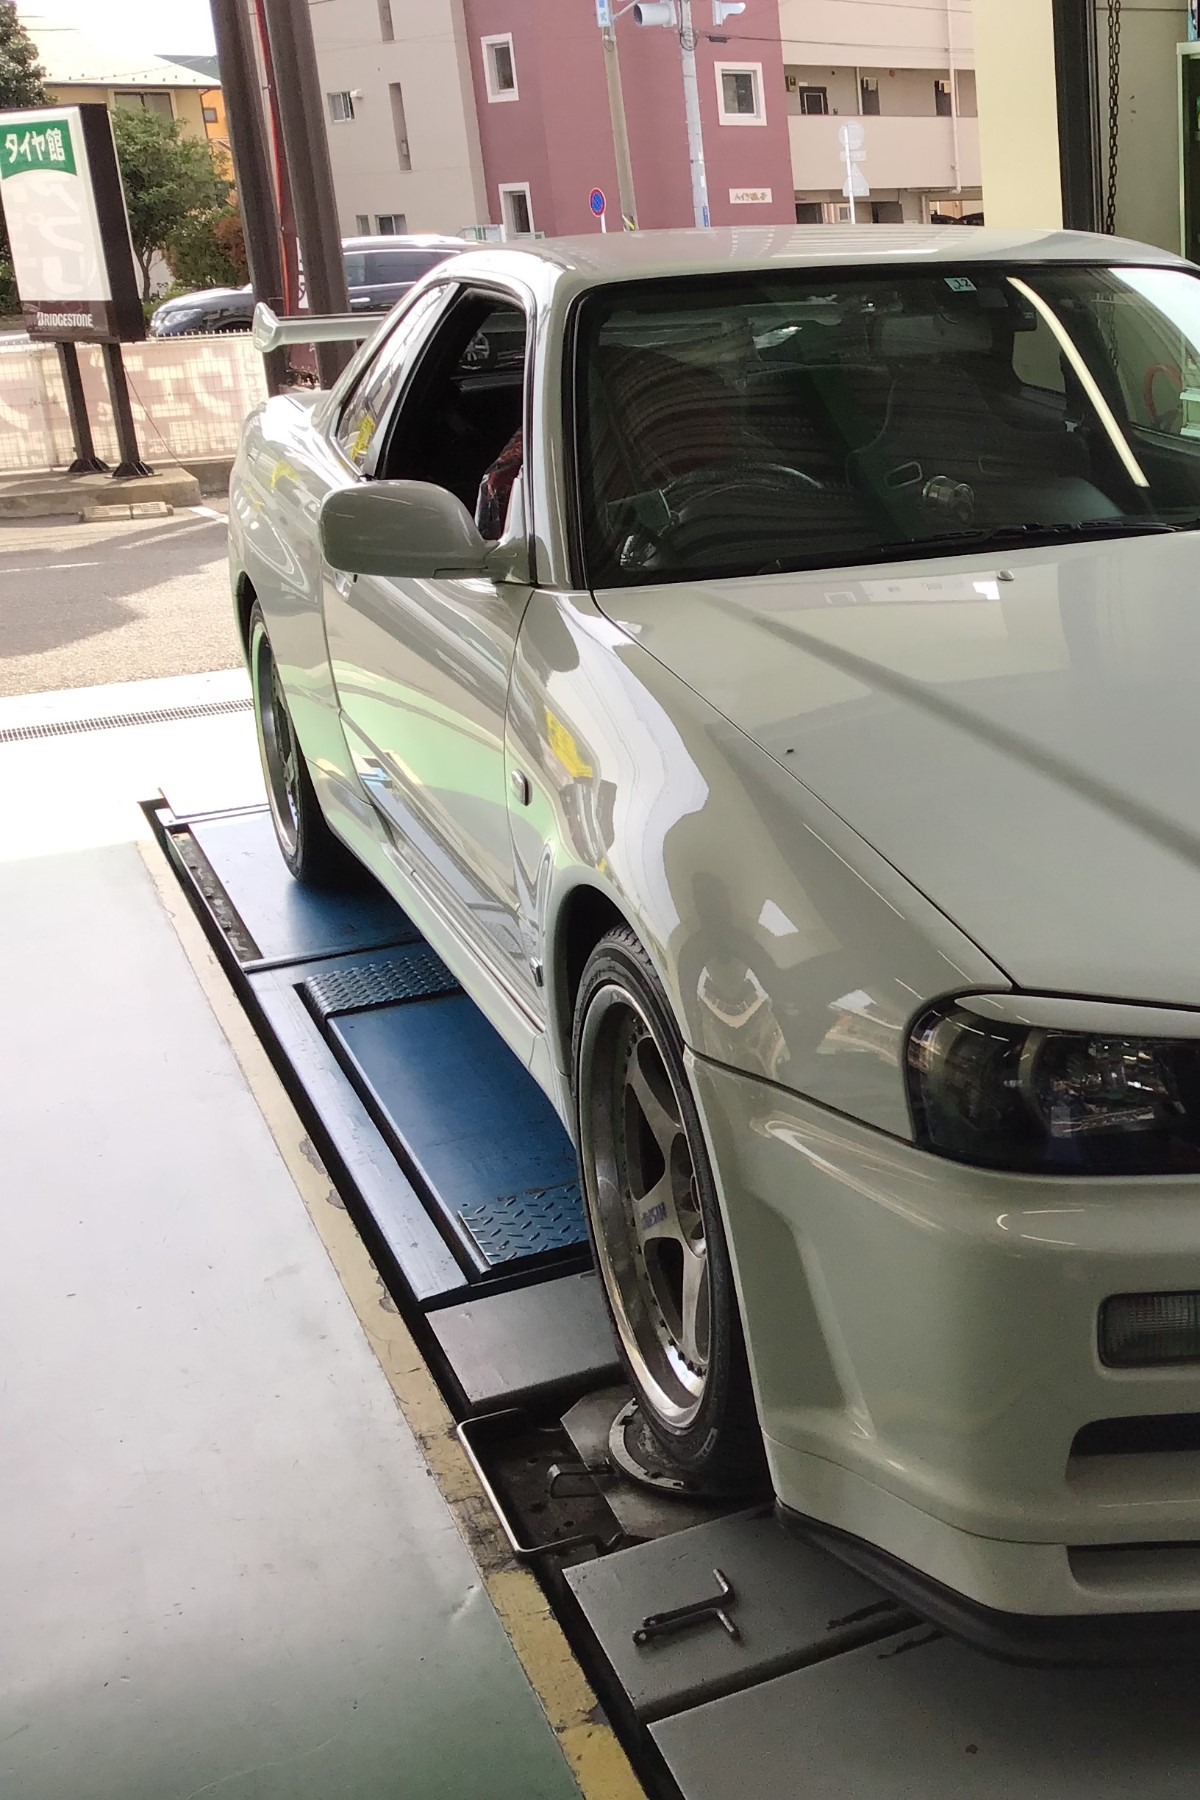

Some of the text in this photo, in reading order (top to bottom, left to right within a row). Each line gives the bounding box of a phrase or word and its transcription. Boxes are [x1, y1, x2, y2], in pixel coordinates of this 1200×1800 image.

[5, 127, 66, 163] タイヤ館
[37, 311, 93, 328] BRIDGESTONE
